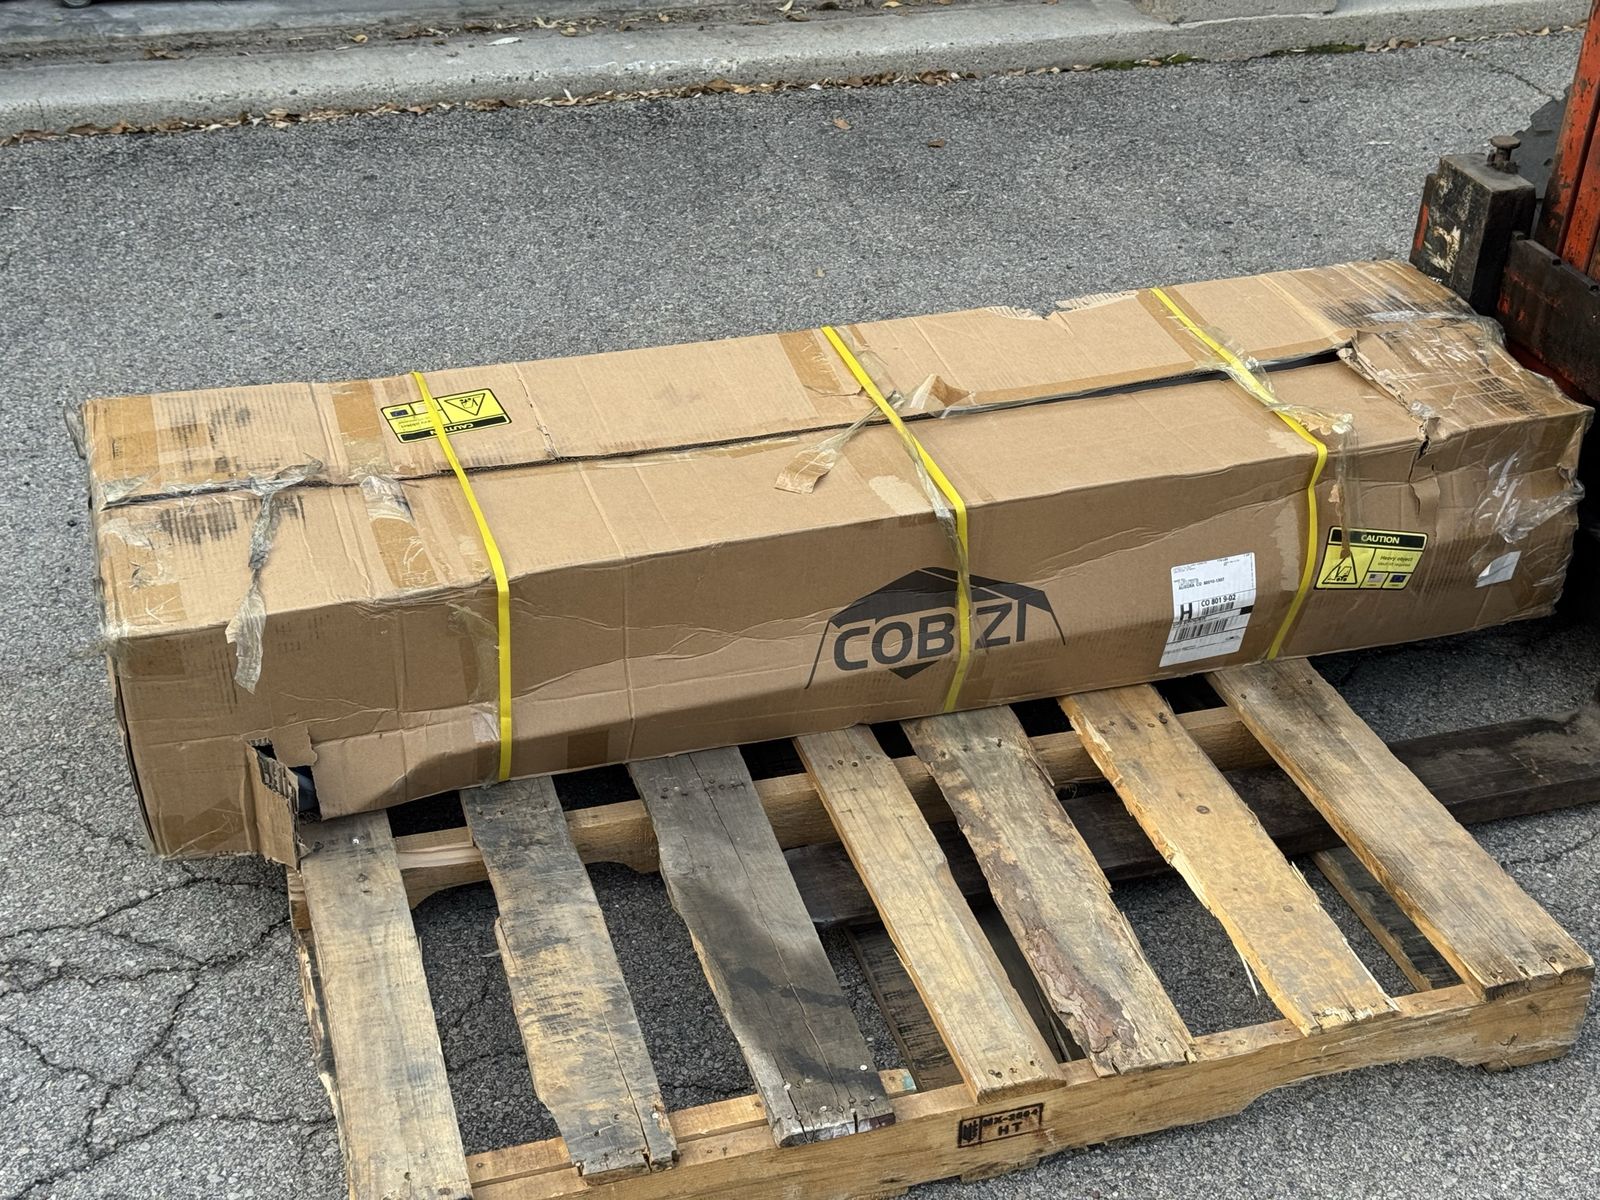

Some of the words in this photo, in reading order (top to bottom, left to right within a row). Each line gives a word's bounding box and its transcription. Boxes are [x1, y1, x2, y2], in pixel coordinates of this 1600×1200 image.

[1361, 534, 1400, 544] CAUTION
[1211, 597, 1222, 605] 801
[1223, 594, 1236, 602] 9-02
[1180, 603, 1192, 620] H
[833, 600, 1027, 671] COBZI
